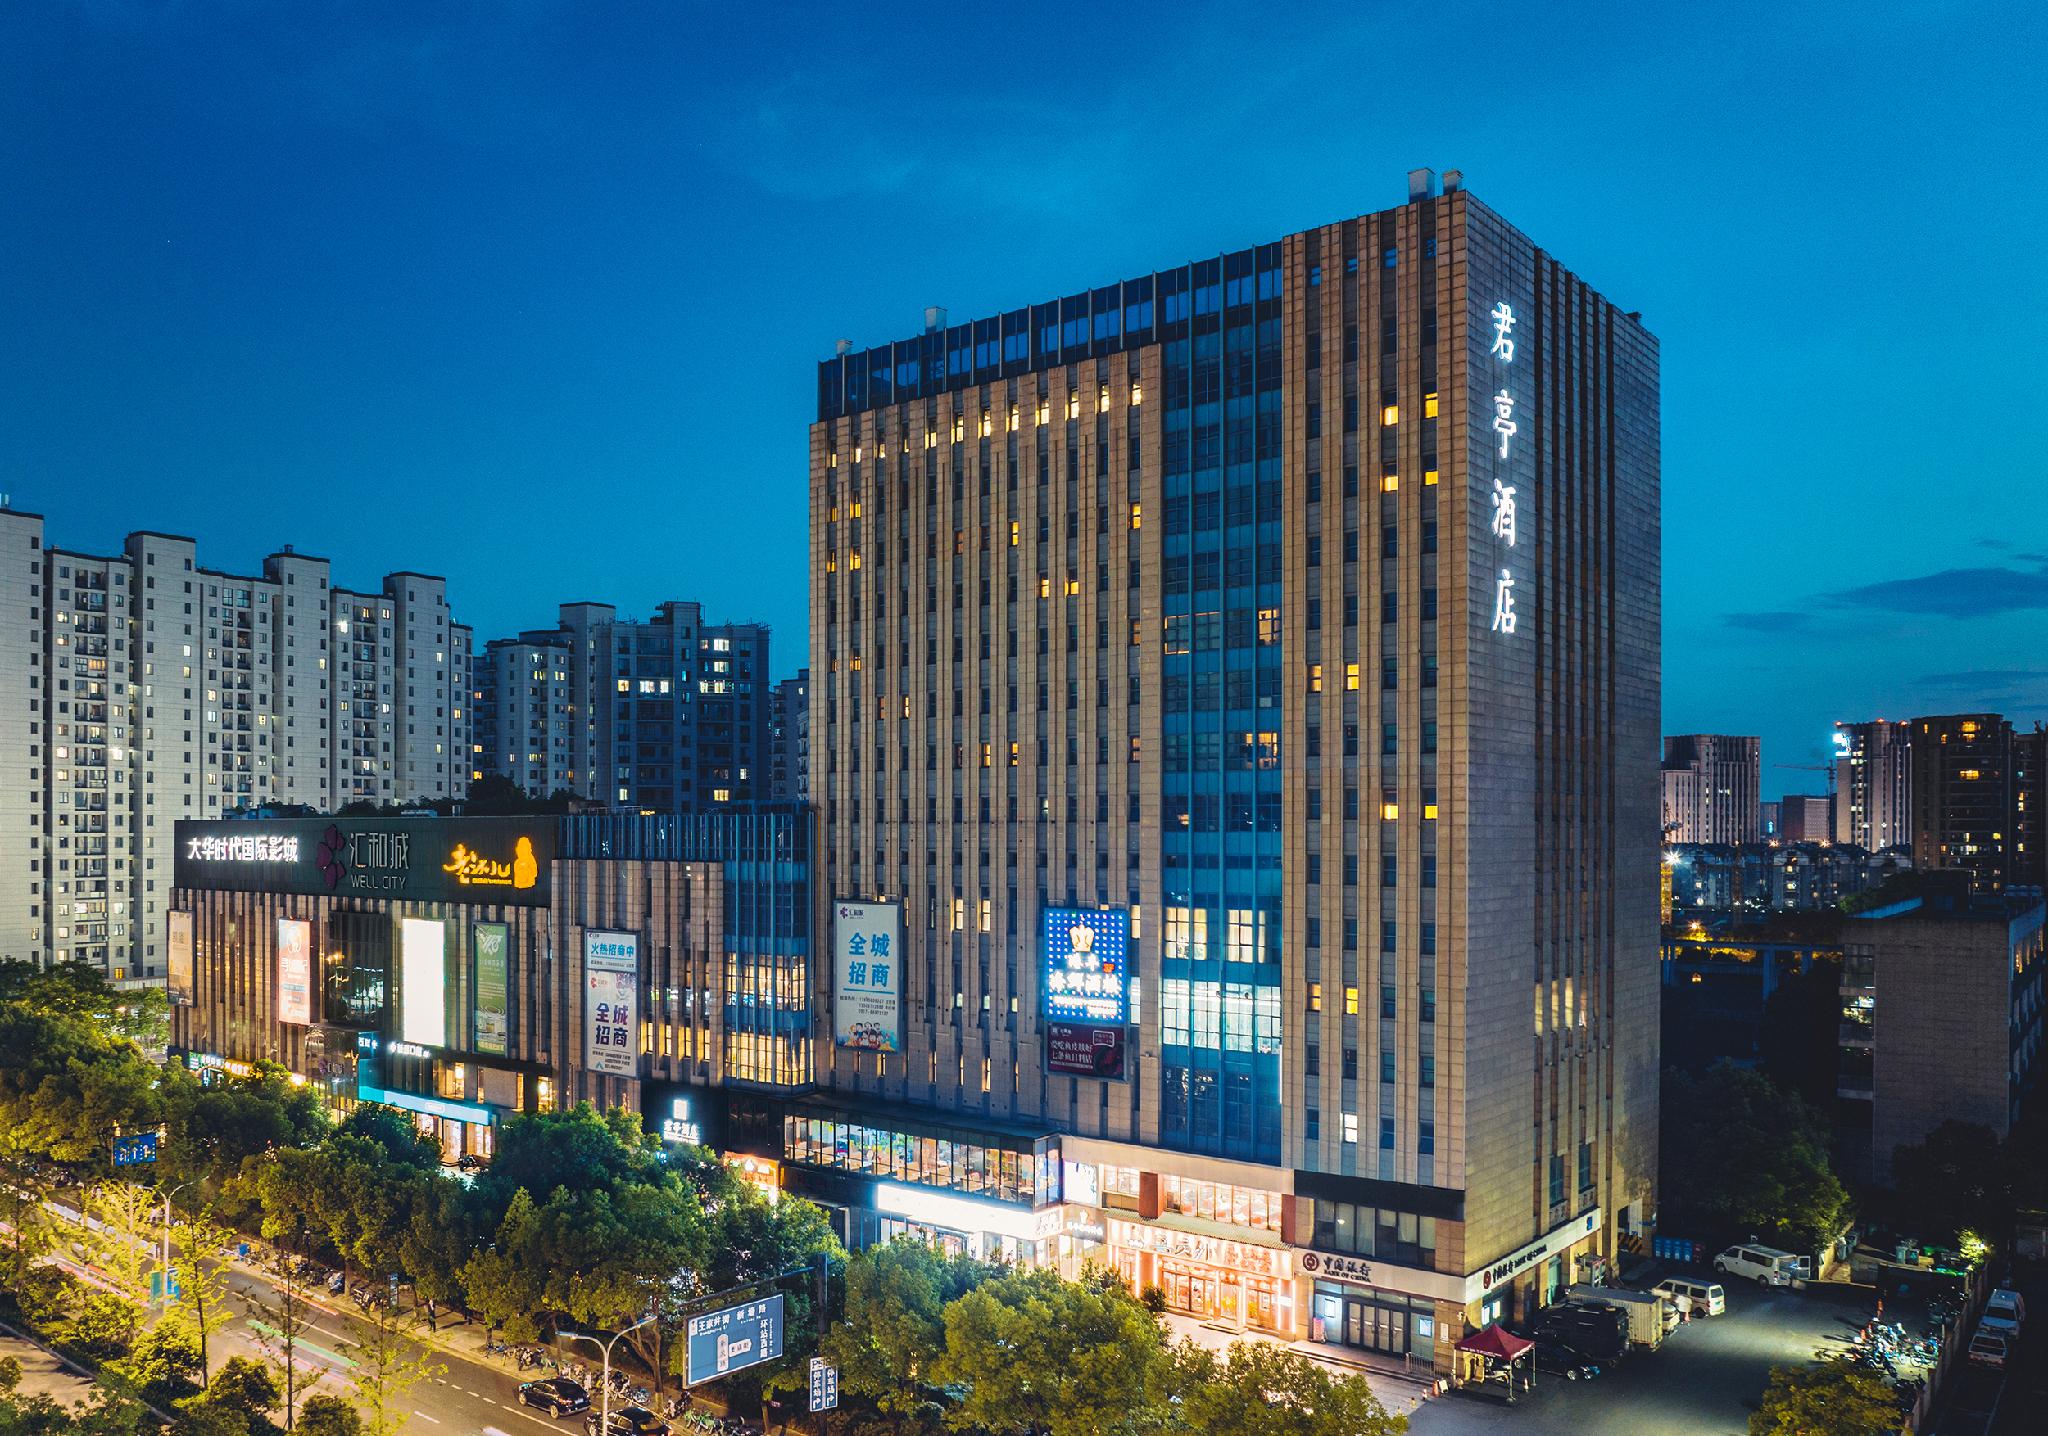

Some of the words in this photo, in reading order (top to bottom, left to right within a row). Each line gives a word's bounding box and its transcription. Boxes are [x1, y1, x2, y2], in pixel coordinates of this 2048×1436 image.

[1490, 301, 1517, 634] 君亭酒店
[187, 836, 298, 862] 大华时代国际影城
[349, 832, 409, 869] 汇和城
[351, 874, 379, 889] WELL
[383, 876, 406, 889] CITY
[591, 943, 635, 957] 火热招商中
[848, 932, 890, 957] 全城
[848, 961, 890, 987] 招商
[596, 1003, 629, 1025] 全城
[596, 1025, 629, 1047] 招商
[1324, 1256, 1372, 1276] 中国银行
